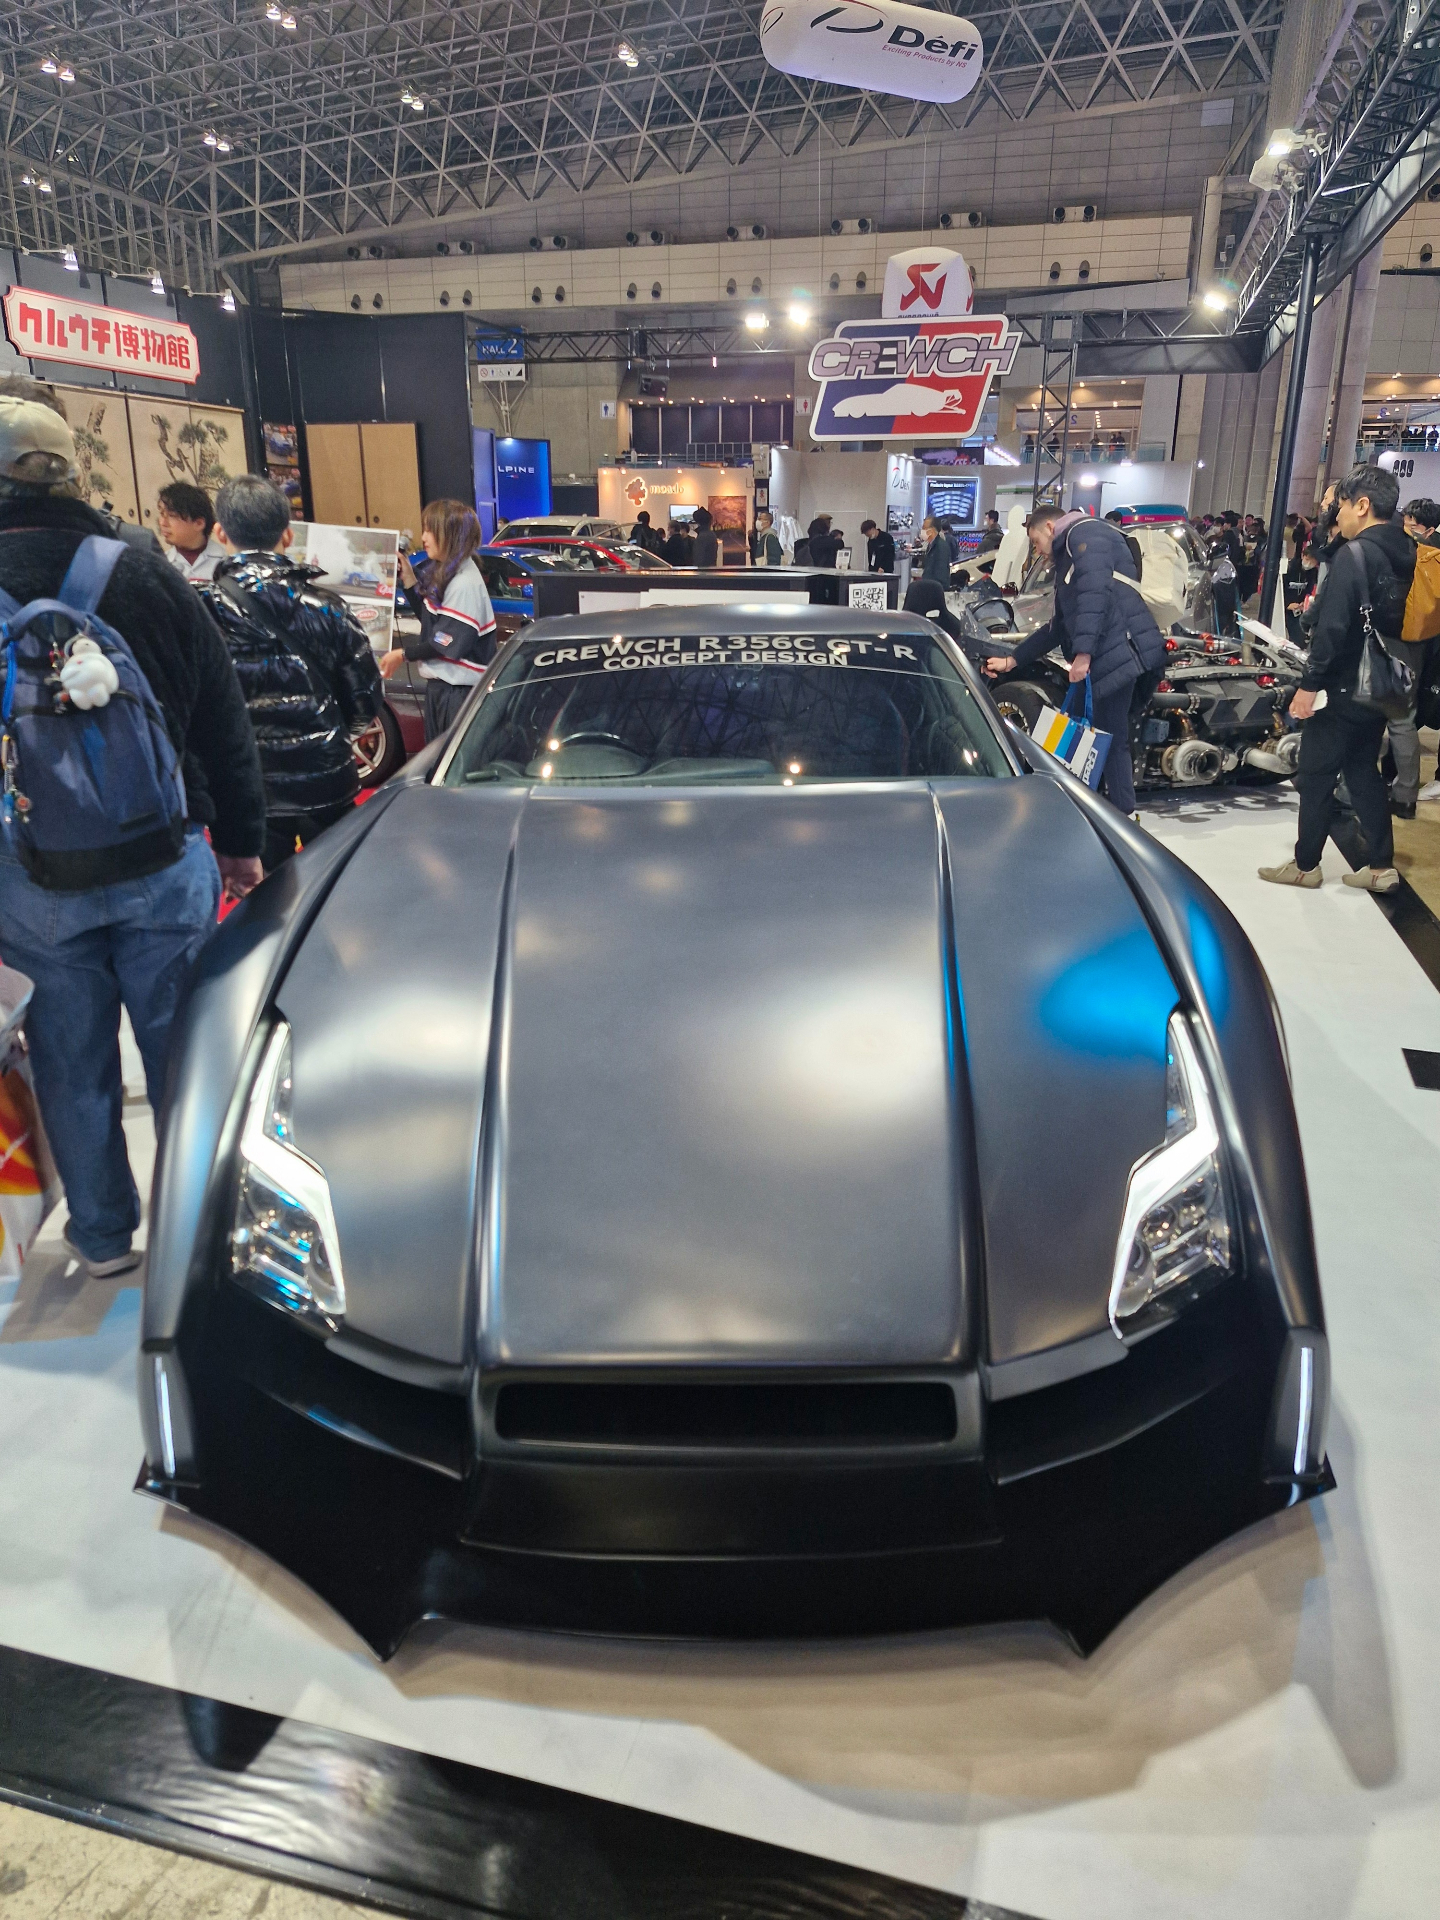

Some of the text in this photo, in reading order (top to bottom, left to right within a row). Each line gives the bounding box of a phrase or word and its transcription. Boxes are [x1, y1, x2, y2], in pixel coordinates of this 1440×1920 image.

[882, 44, 912, 57] Exciting
[913, 51, 945, 64] Products
[946, 59, 955, 67] by
[887, 25, 979, 61] Défi
[19, 302, 191, 370] クルウチ博物館
[482, 338, 518, 355] HALL 2
[811, 336, 1018, 378] CREWCH
[497, 465, 535, 474] LPINE
[533, 637, 681, 667] CREWCH
[826, 638, 918, 662] GT-R
[603, 650, 848, 670] CONCEPT DESIGN
